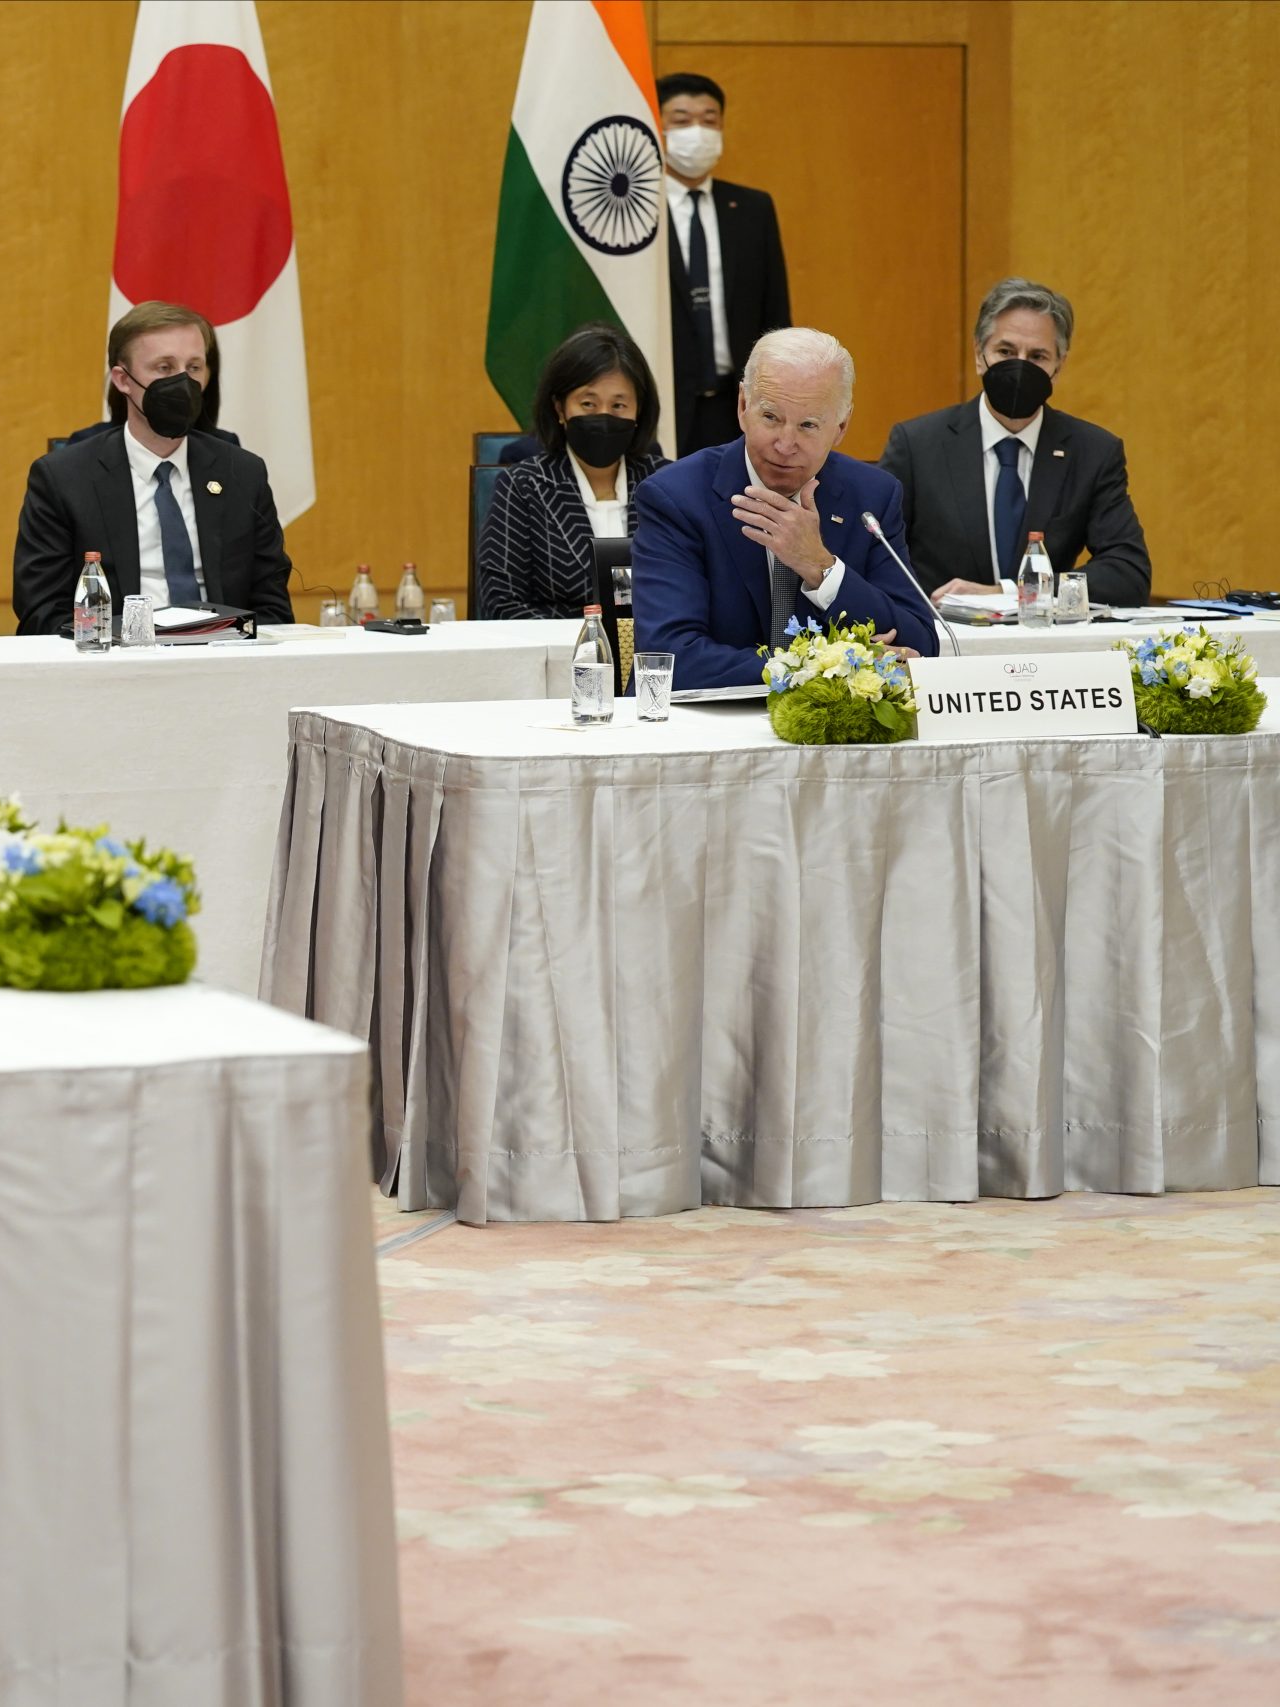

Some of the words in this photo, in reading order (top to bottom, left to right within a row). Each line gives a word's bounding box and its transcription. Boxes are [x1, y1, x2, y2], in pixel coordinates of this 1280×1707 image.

[1004, 662, 1038, 674] QUAD
[928, 691, 1022, 715] UNITED
[1030, 687, 1123, 711] STATES
